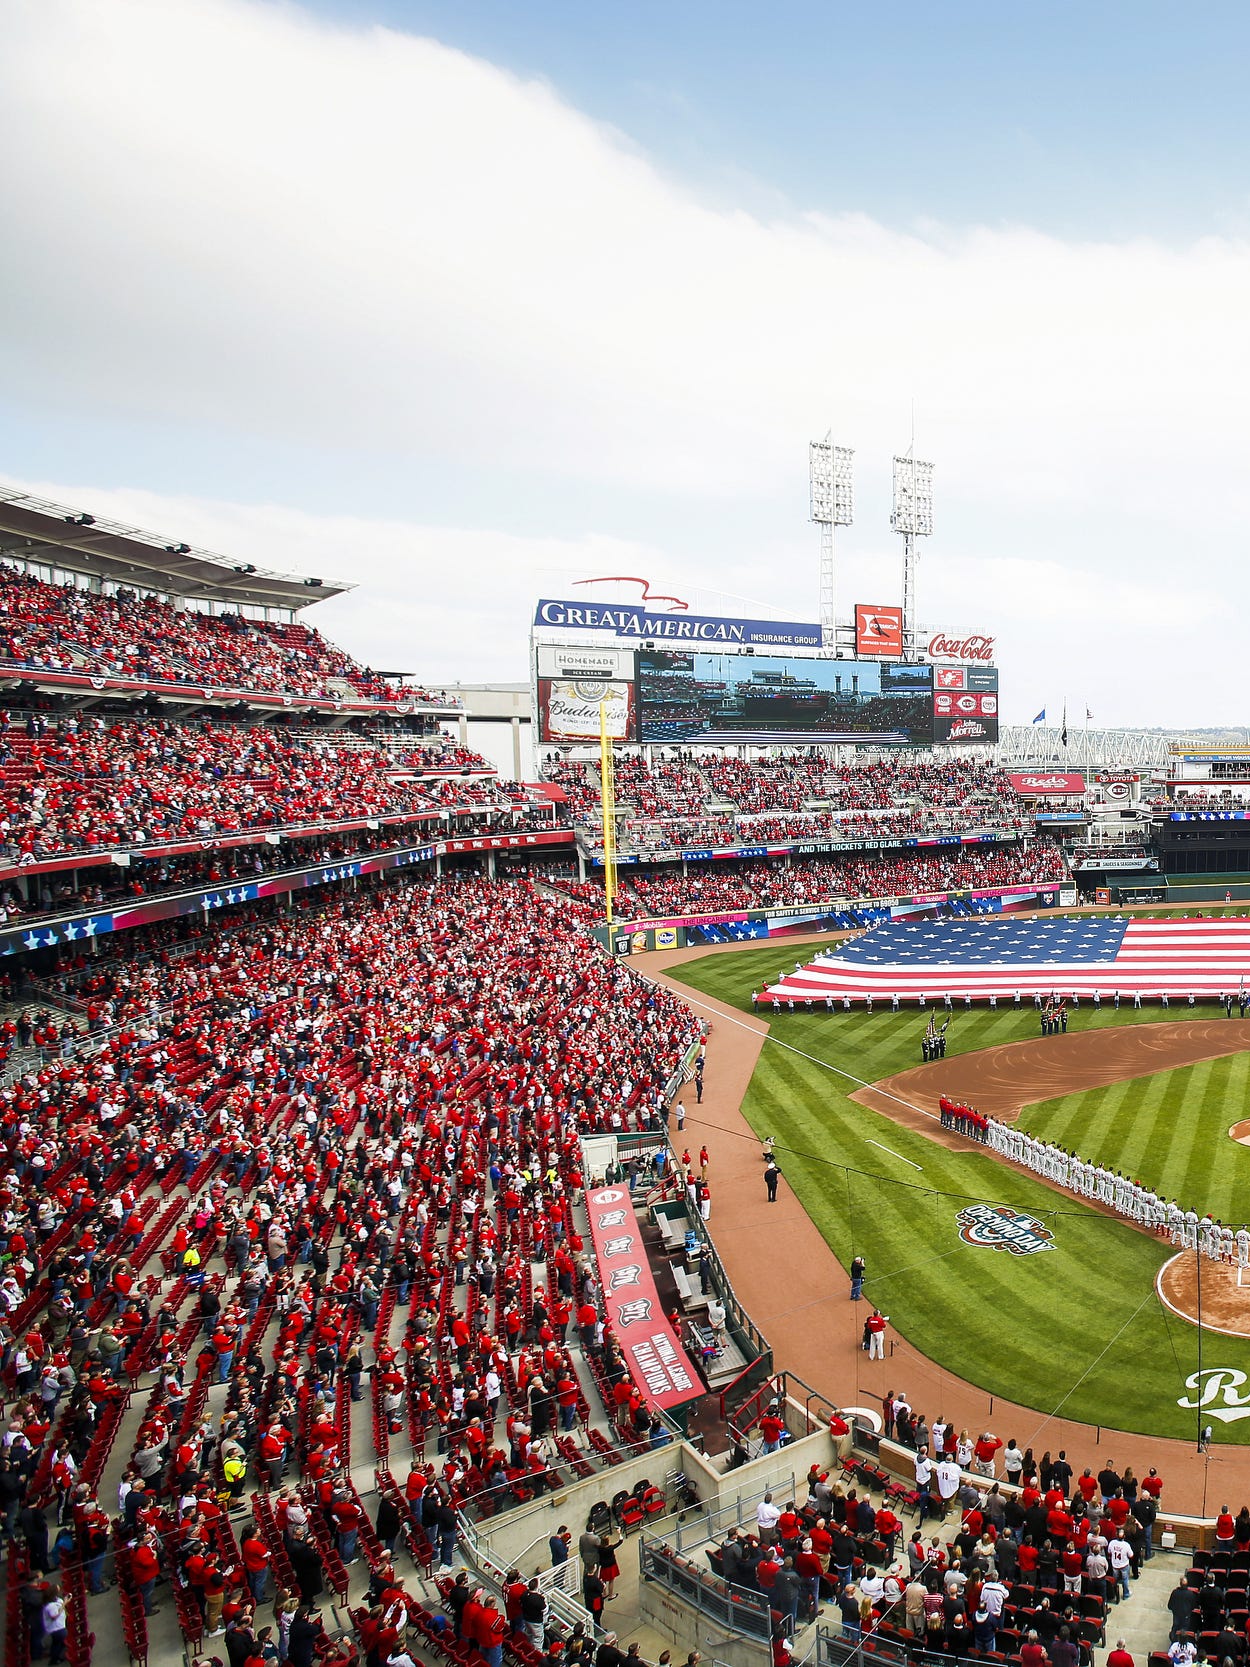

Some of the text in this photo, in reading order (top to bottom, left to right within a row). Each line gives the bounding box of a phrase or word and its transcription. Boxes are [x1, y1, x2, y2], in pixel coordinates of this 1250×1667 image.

[541, 603, 630, 627] GREAT
[750, 633, 818, 645] INSURANCE GROUP
[558, 655, 614, 665] HOMEMADE
[549, 700, 628, 719] Budwiser
[1021, 776, 1069, 787] Reds
[798, 845, 815, 854] AND
[816, 844, 830, 852] THE
[865, 841, 878, 849] RED
[765, 910, 775, 918] FOR
[775, 909, 794, 917] SAFETY
[799, 907, 820, 915] SERVICE
[858, 902, 873, 910] ISSUE
[965, 1205, 1054, 1253] OPENING DAY
[623, 1300, 649, 1323] 1972
[631, 1341, 673, 1396] CHAMPIONS
[650, 1332, 694, 1393] NATIONAL LEAGUE
[1114, 1551, 1122, 1561] 14
